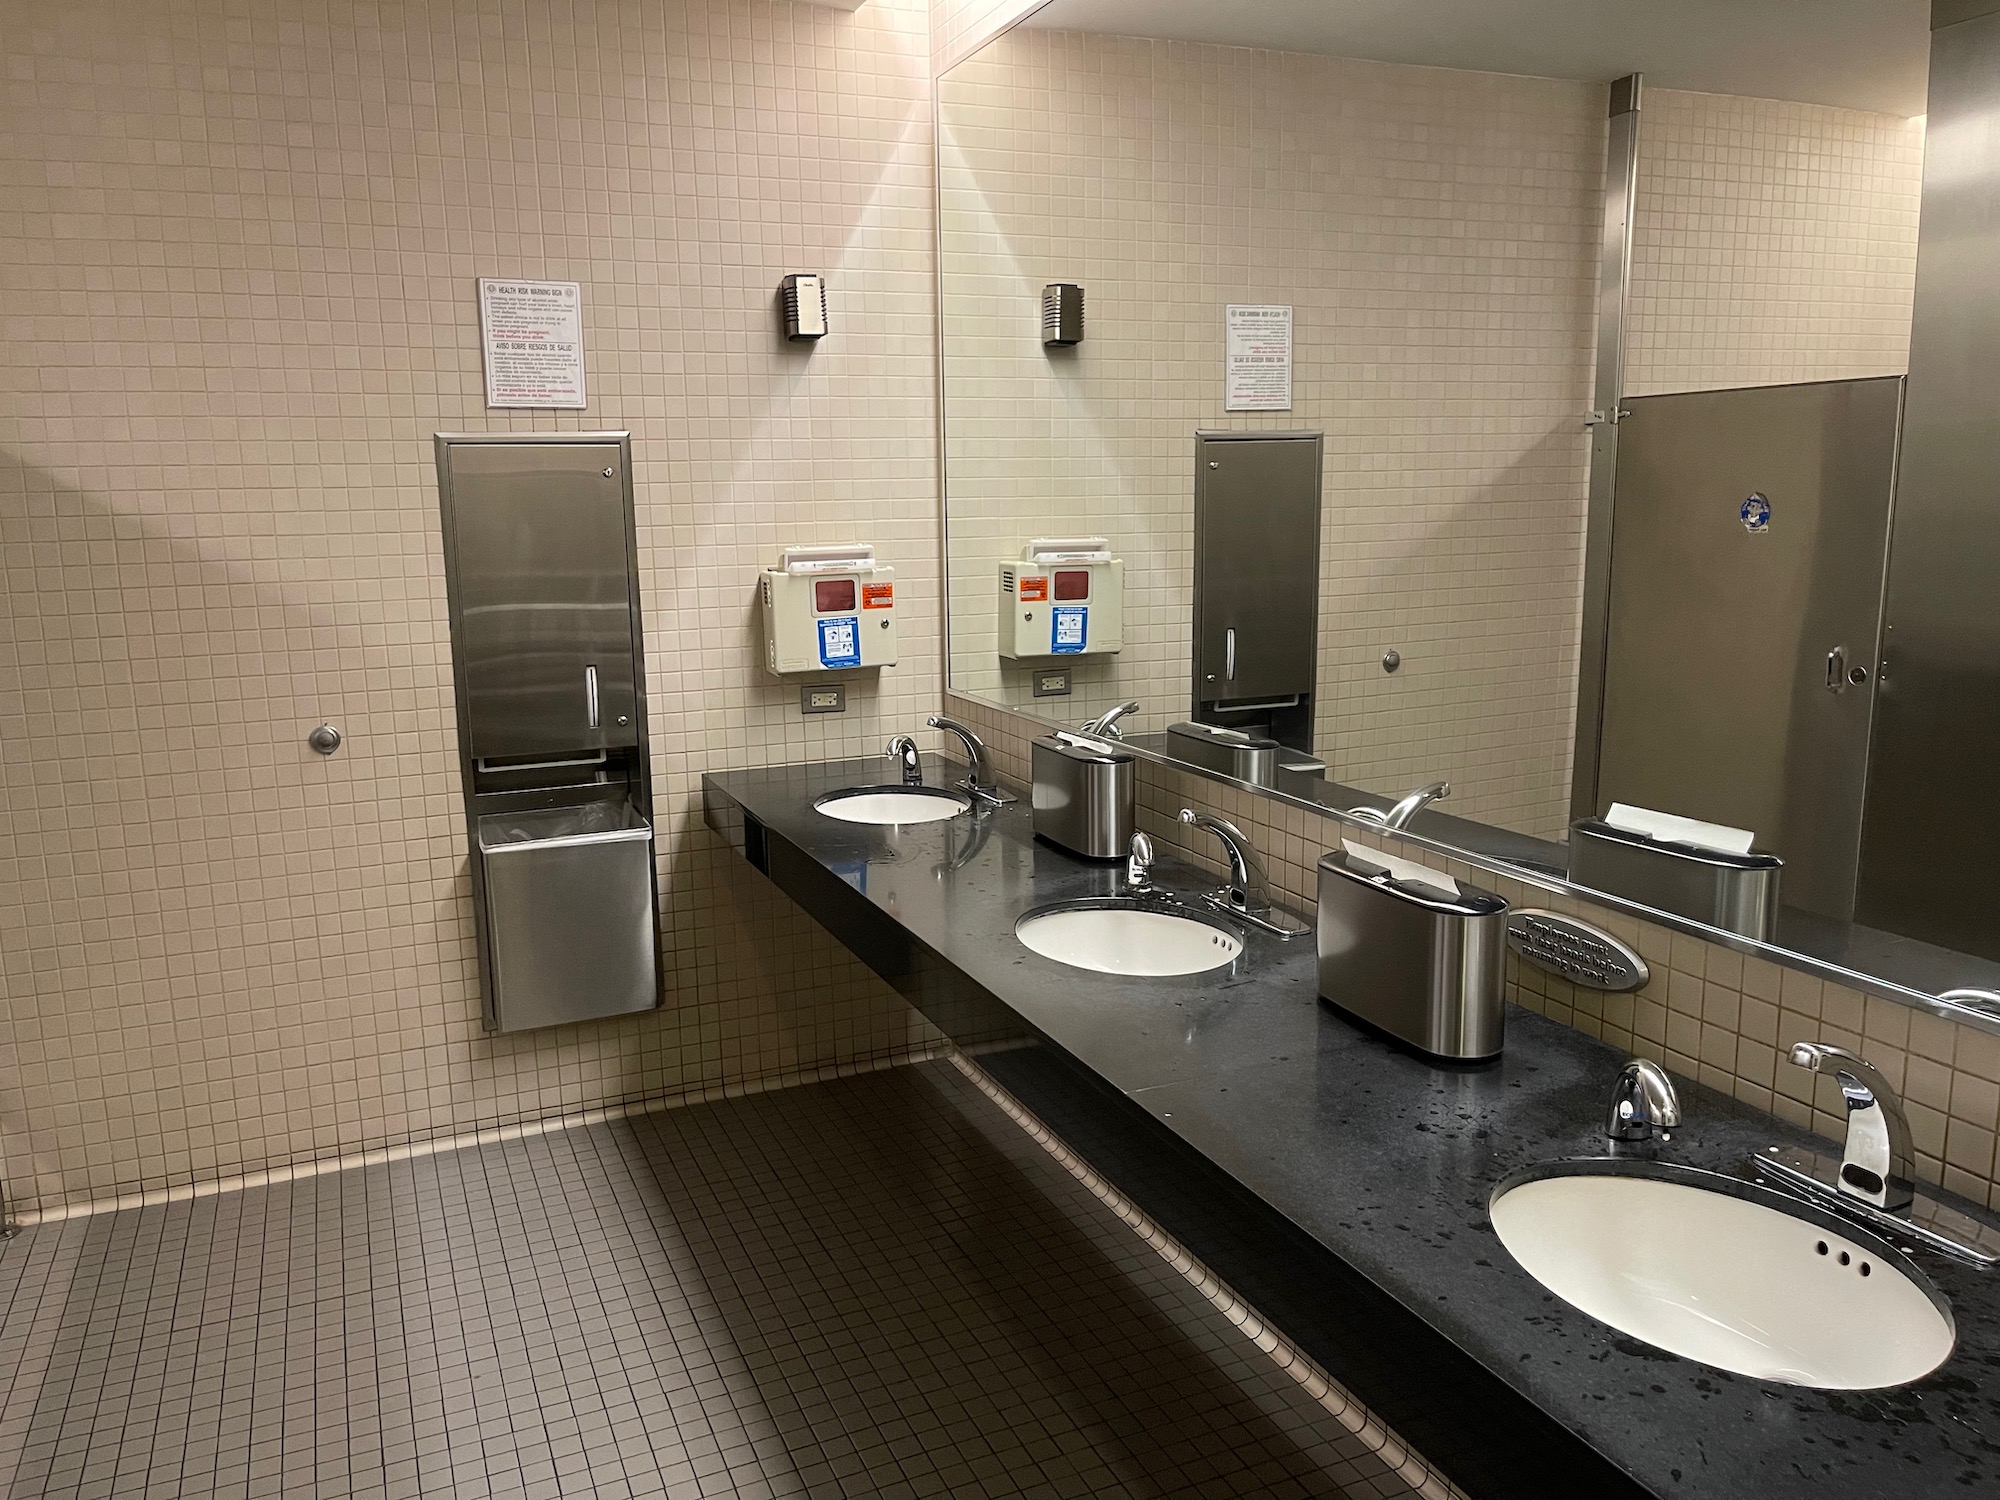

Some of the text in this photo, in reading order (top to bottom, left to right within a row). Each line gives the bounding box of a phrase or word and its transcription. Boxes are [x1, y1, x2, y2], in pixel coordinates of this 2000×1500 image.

[1508, 926, 1627, 977] wash their hands before
[1525, 916, 1609, 956] Employees must
[1522, 944, 1610, 985] returning to work
